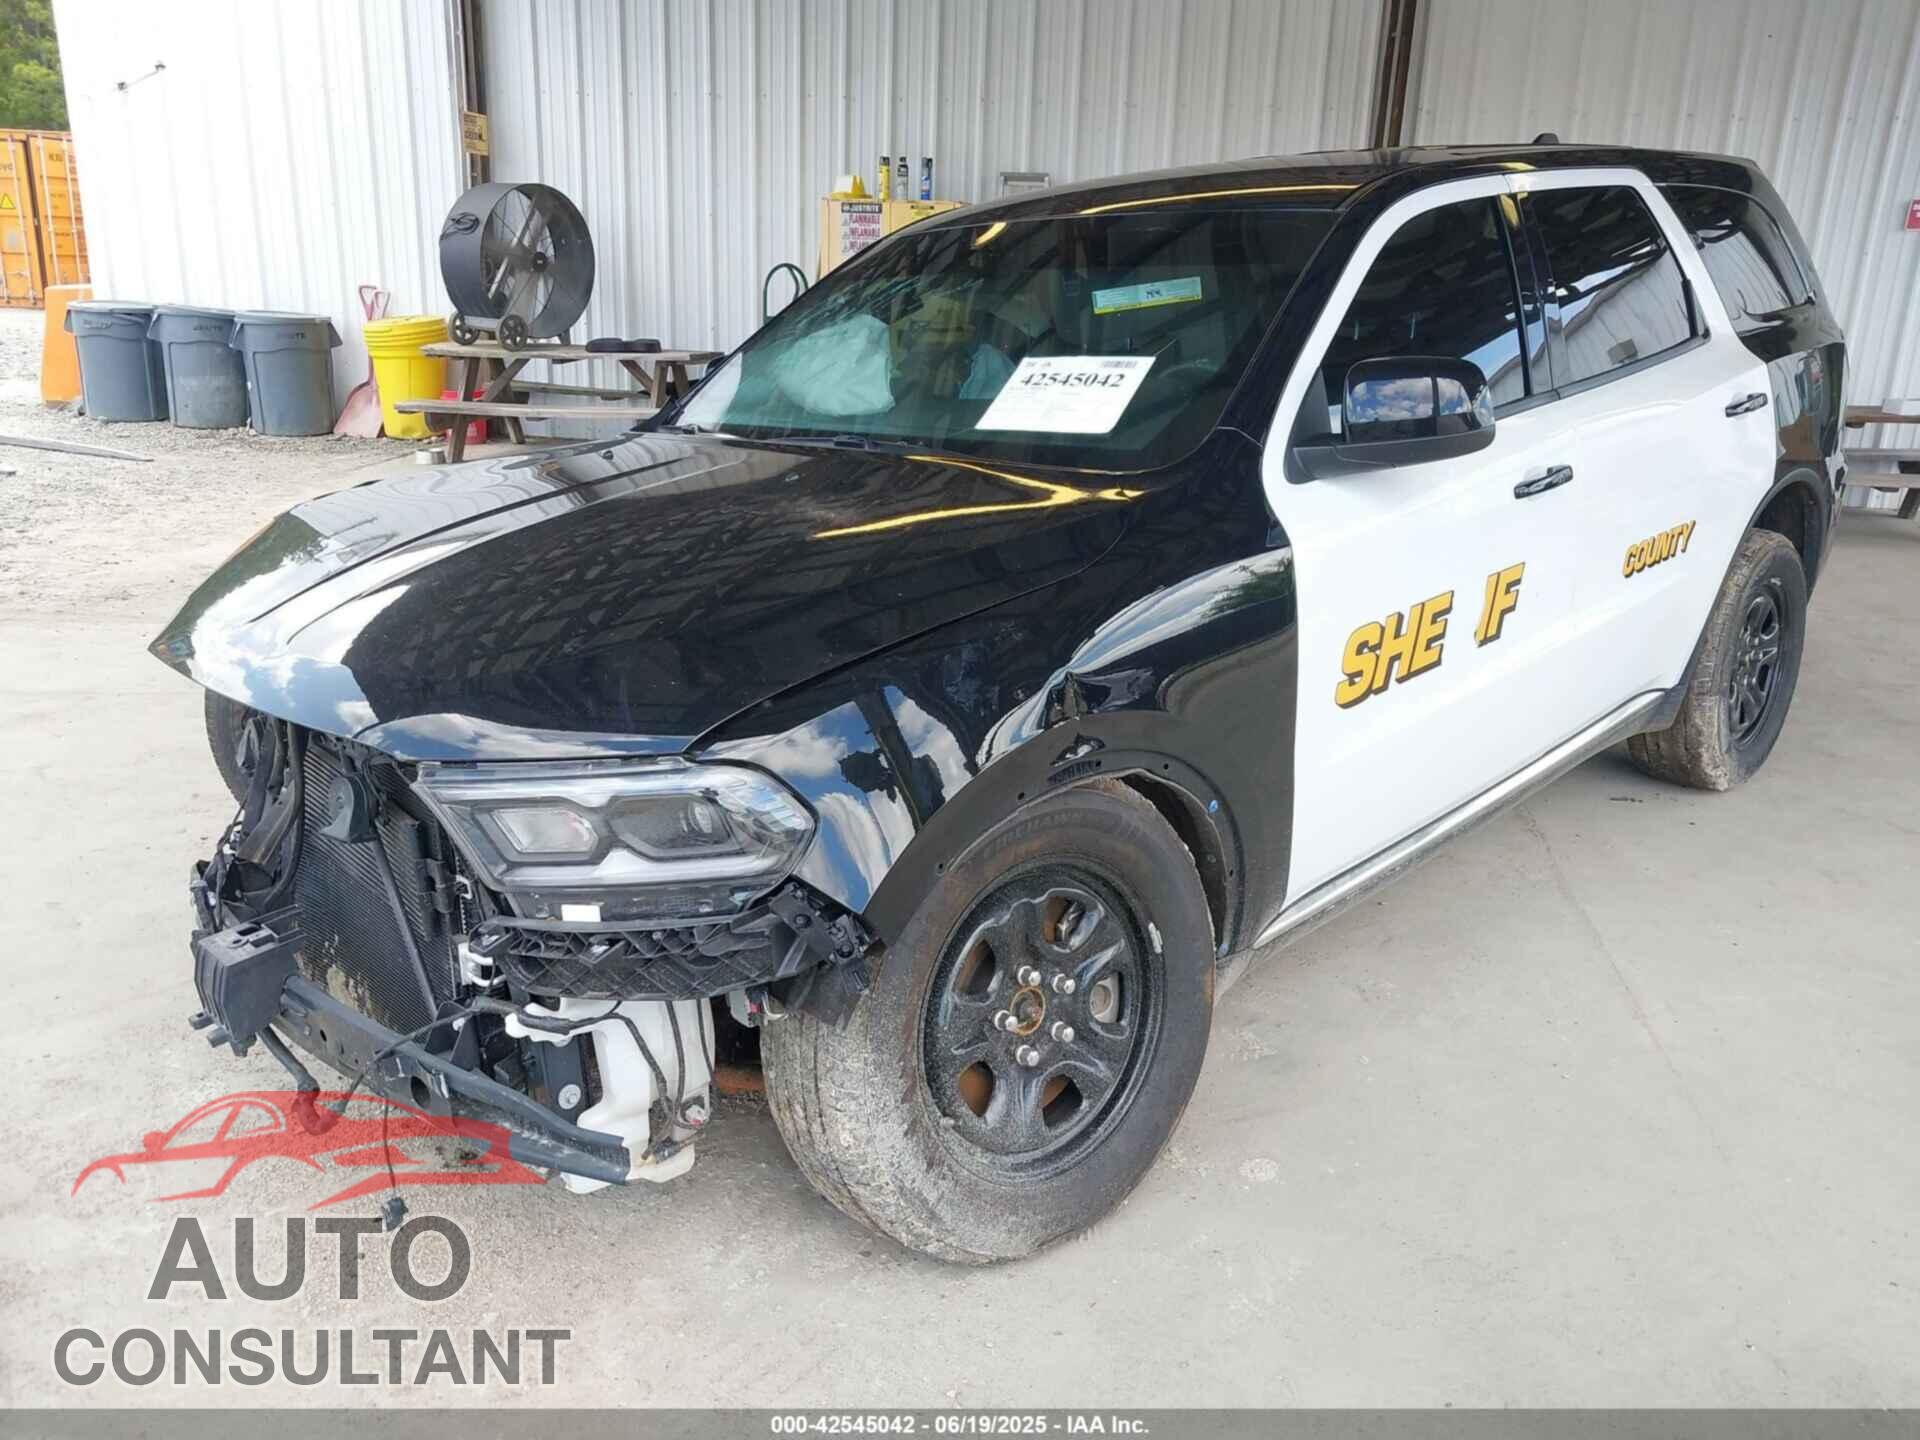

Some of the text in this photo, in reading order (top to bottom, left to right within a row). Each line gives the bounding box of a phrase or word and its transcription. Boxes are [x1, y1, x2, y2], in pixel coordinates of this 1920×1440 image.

[849, 214, 880, 224] FLAMMABLE
[1020, 373, 1124, 388] 42545042
[1622, 520, 1696, 578] COUNTY
